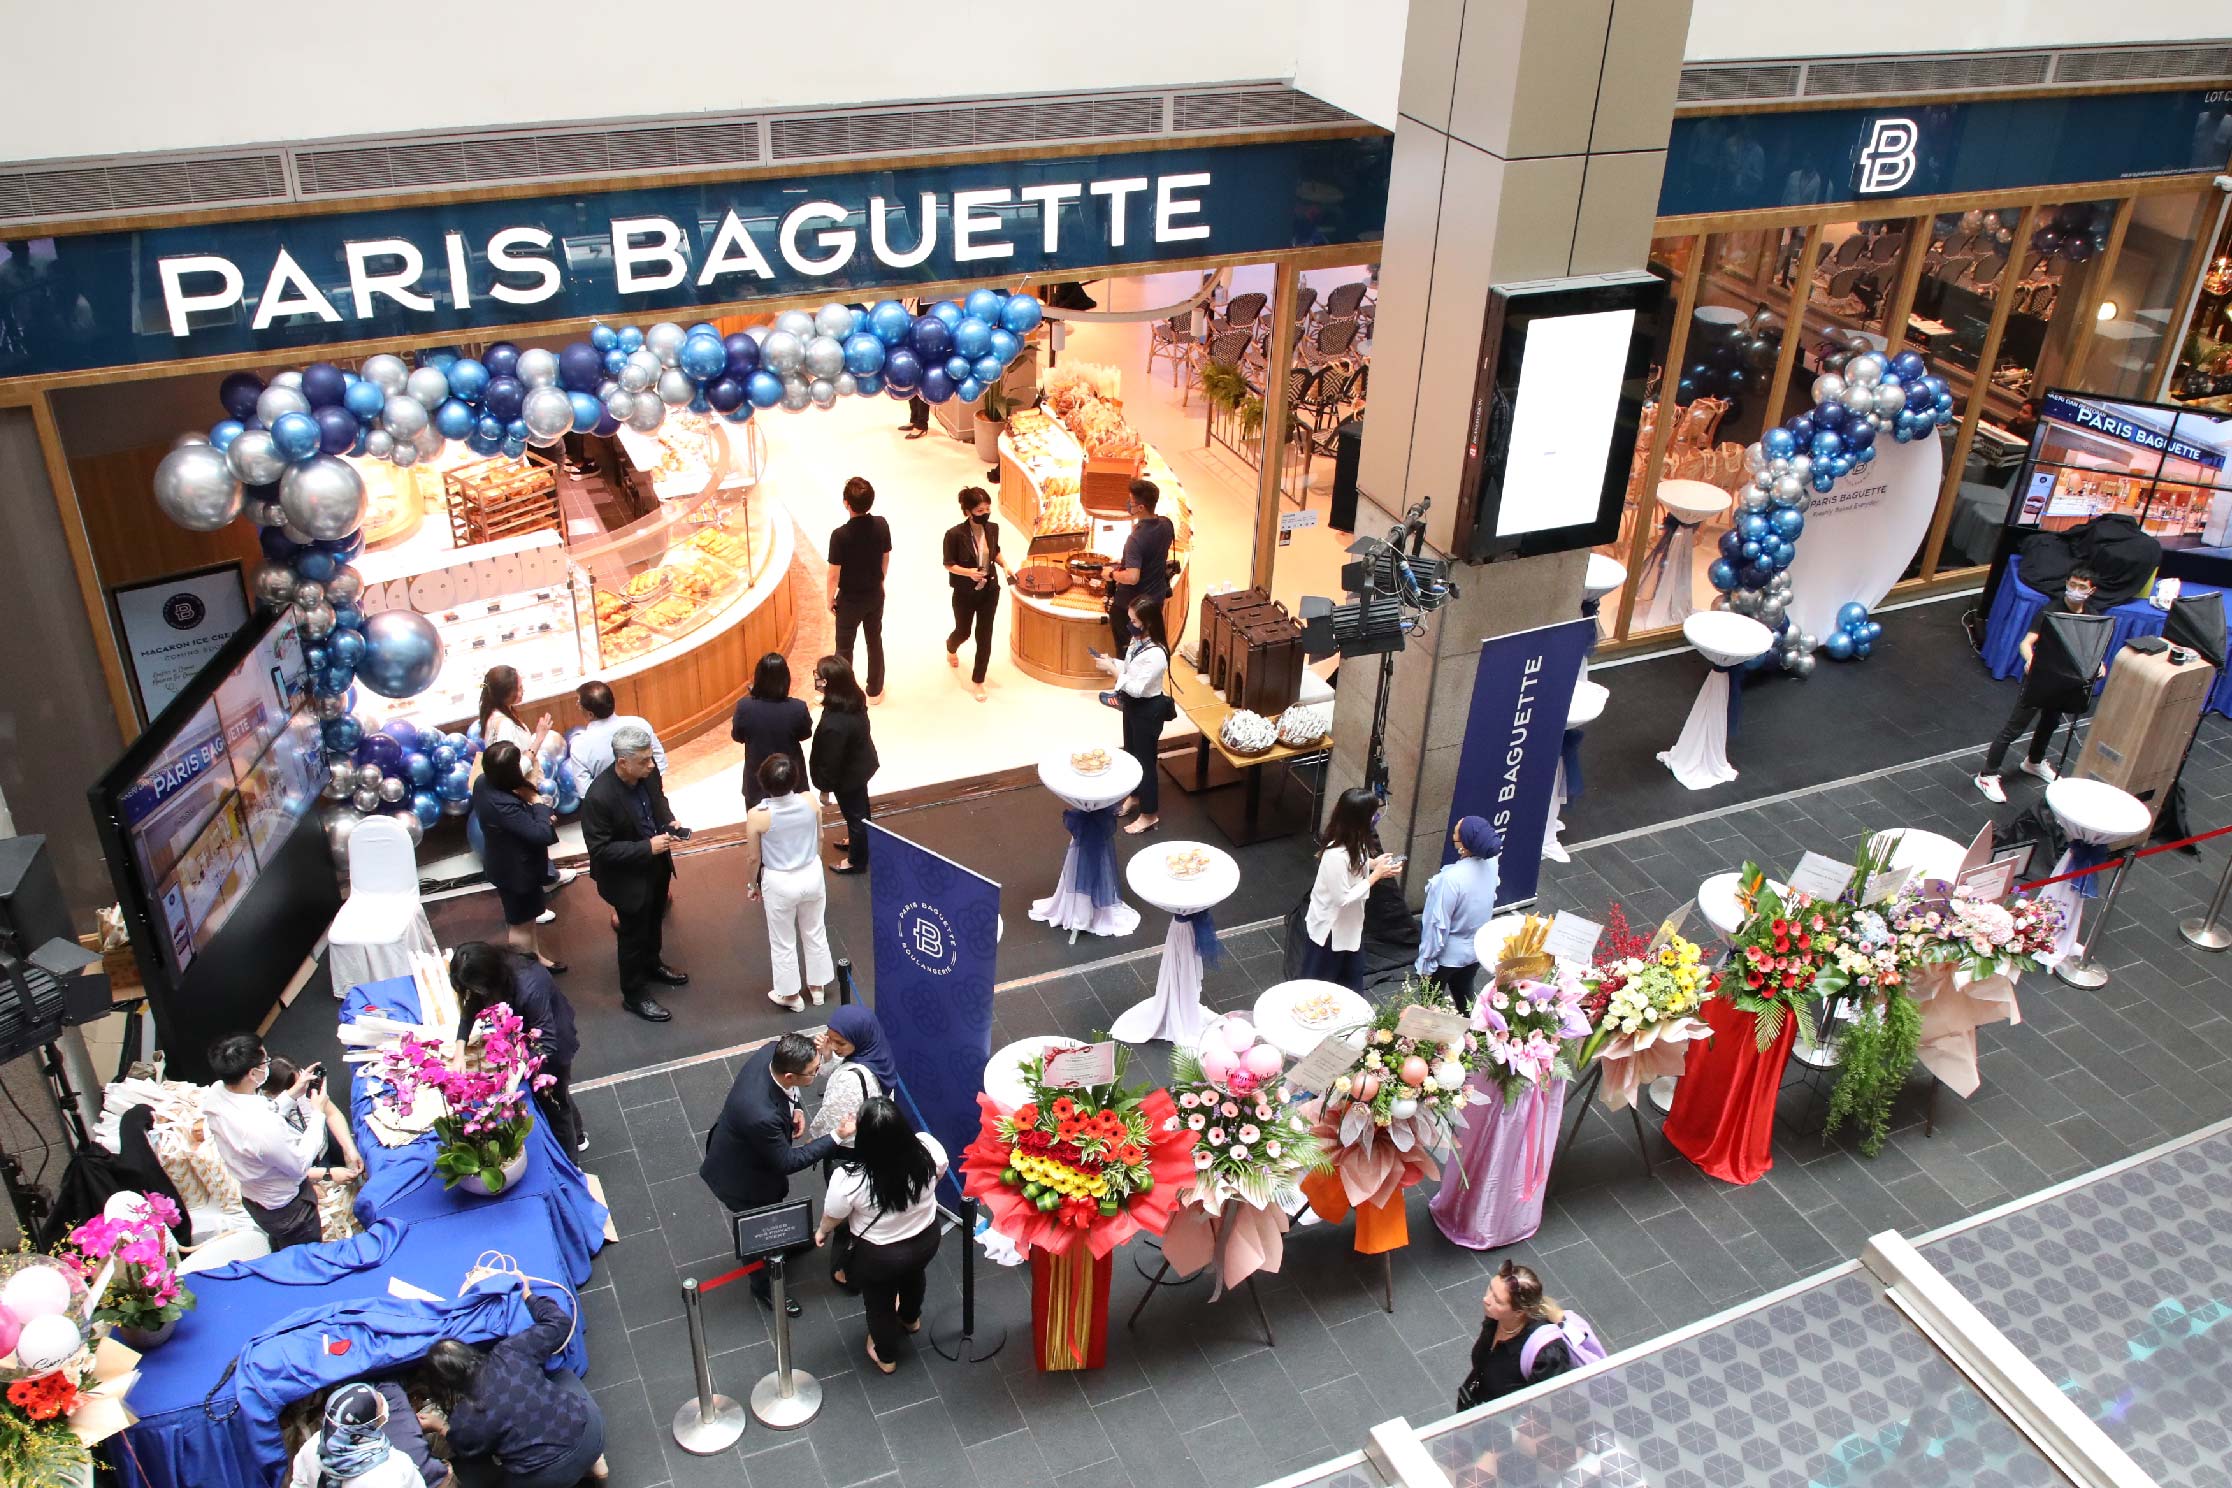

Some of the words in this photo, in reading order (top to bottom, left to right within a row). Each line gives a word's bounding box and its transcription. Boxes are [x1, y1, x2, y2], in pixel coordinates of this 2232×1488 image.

[157, 226, 562, 337] PARIS
[609, 172, 1211, 295] BAGUETTE
[2076, 408, 2132, 439] PARIS
[2135, 430, 2202, 460] BAGUETTE
[1810, 495, 1838, 508] PARIS
[1839, 485, 1888, 503] BAGUETTE
[140, 641, 190, 658] MACARON
[192, 636, 209, 646] ICE
[1498, 655, 1543, 803] BAGUETTE
[153, 753, 200, 799] PARIS
[899, 901, 918, 919] PARIS
[921, 902, 957, 947] BAGUETTE
[902, 942, 952, 976] BOULANGERIE
